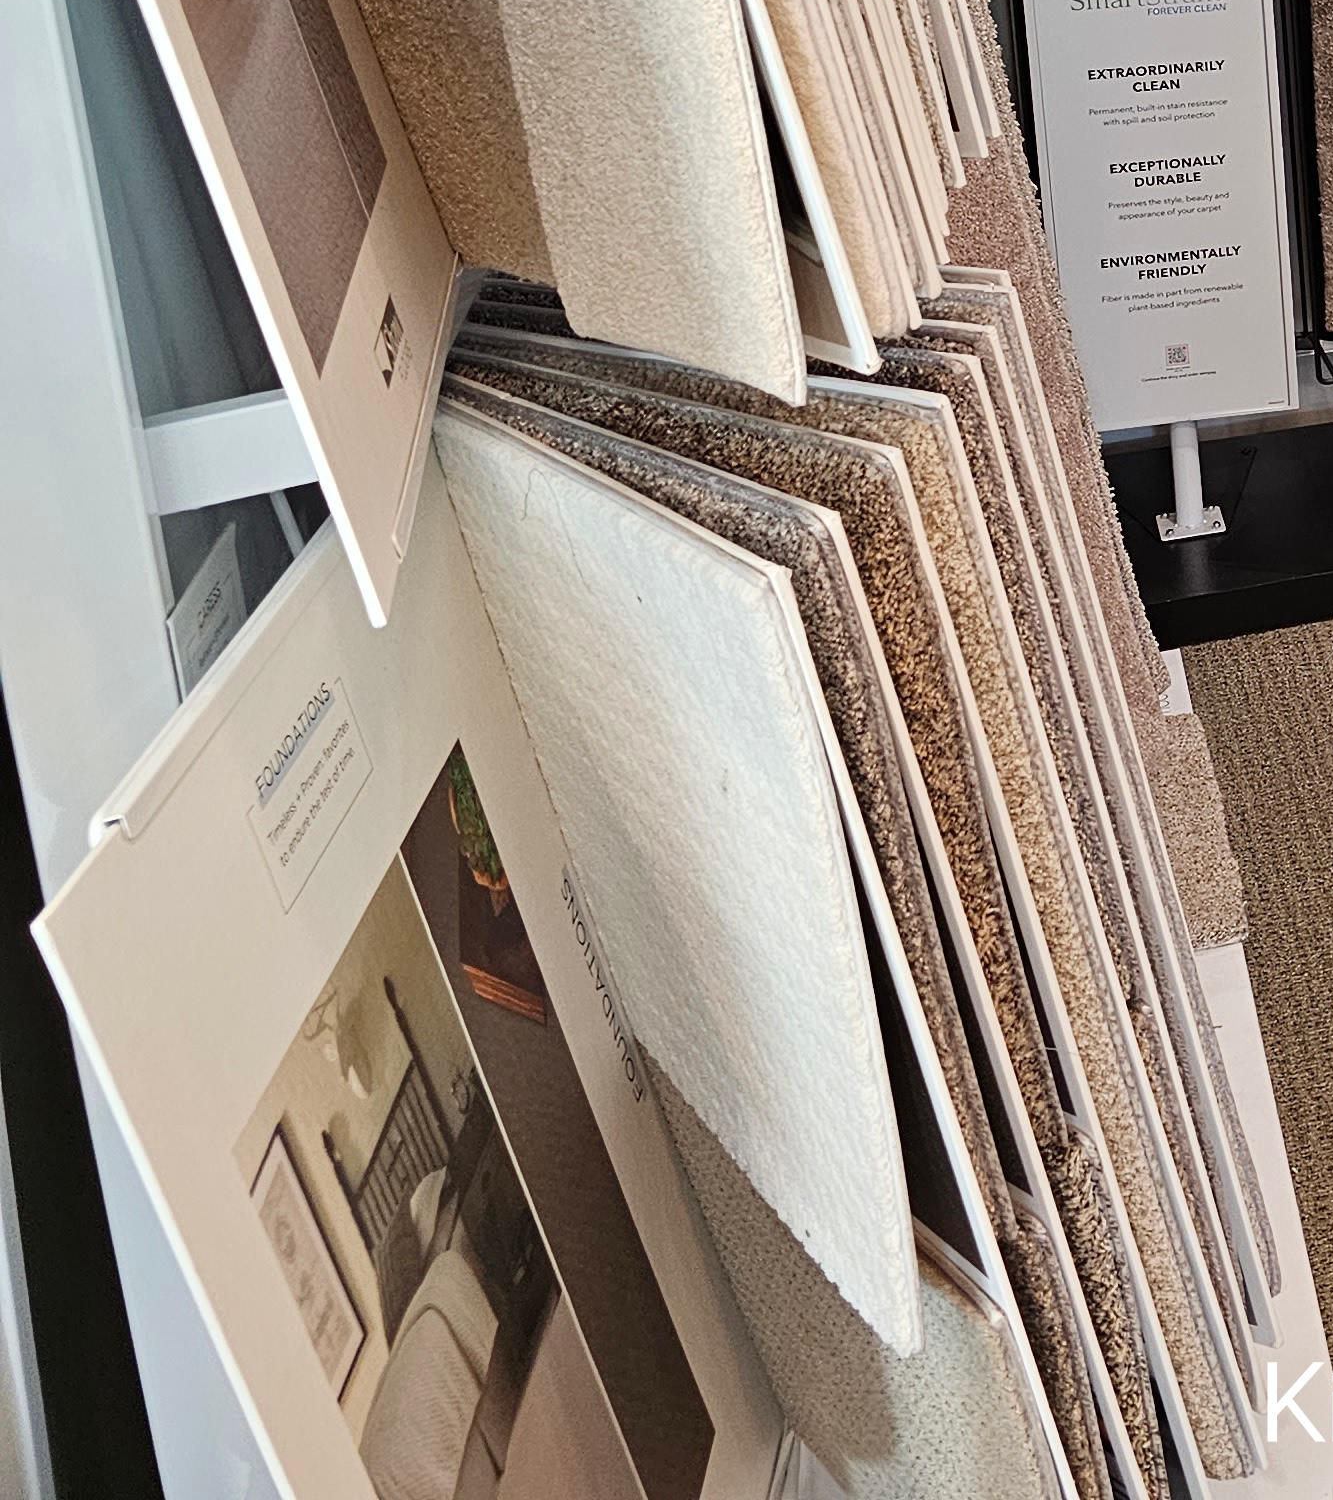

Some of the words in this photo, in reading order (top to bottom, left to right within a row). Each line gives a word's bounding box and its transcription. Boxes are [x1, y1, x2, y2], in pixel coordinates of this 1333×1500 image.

[1147, 5, 1192, 16] FOREVER
[1194, 3, 1227, 13] CLEAN
[1087, 59, 1225, 81] EXTRAORDINARILY
[1132, 79, 1181, 93] CLEAN
[1088, 106, 1136, 116] Permanent,
[1166, 102, 1186, 111] stain
[1187, 99, 1228, 108] resistance
[1103, 117, 1120, 126] with
[1121, 116, 1139, 126] spill
[1140, 115, 1157, 123] and
[1158, 113, 1173, 122] soil
[1173, 111, 1215, 122] protection
[1109, 154, 1226, 174] EXCEPTIONALLY
[1134, 171, 1202, 188] DURABLE
[1108, 200, 1147, 209] Preserves
[1148, 198, 1161, 206] the
[1185, 194, 1213, 203] beauty
[1214, 191, 1230, 200] and
[1118, 210, 1165, 220] appearance
[1166, 208, 1176, 216] of
[1177, 207, 1195, 217] your
[1196, 205, 1222, 214] carpet
[1100, 245, 1242, 269] ENVIRONMENTALLY
[1138, 263, 1207, 280] FRIENDLY
[1131, 291, 1155, 301] made
[1165, 288, 1182, 299] part
[1183, 287, 1202, 295] from
[1203, 283, 1244, 293] renewable
[1176, 297, 1220, 308] ingredients
[255, 682, 331, 799] FOUNDATIONS
[561, 878, 643, 1103] FOUNDATIONS
